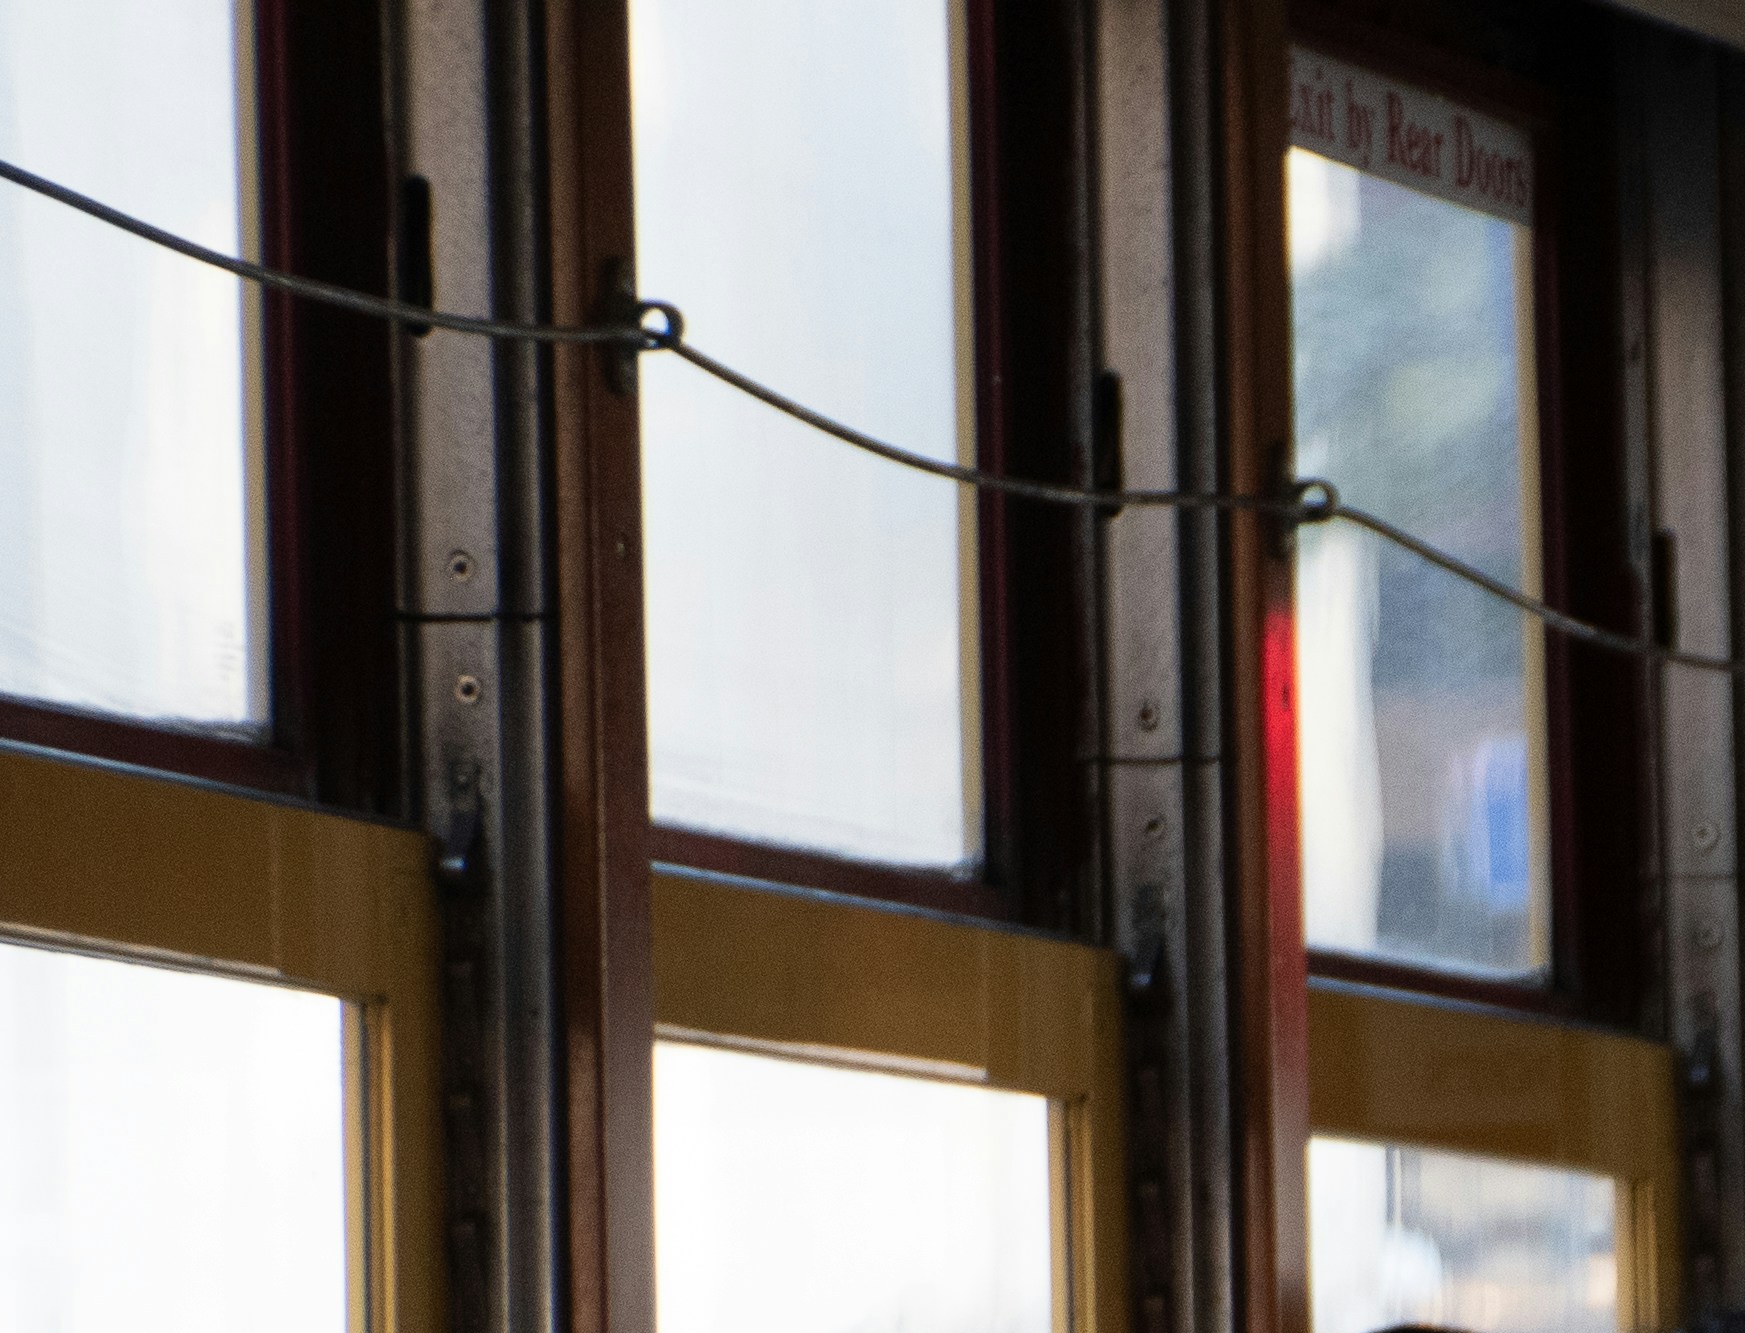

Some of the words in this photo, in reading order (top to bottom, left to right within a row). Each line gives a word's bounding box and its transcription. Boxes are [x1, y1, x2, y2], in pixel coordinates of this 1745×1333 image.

[1291, 65, 1335, 141] xit
[1345, 79, 1375, 167] by
[1386, 91, 1443, 177] Rear
[1454, 115, 1528, 207] Doors
